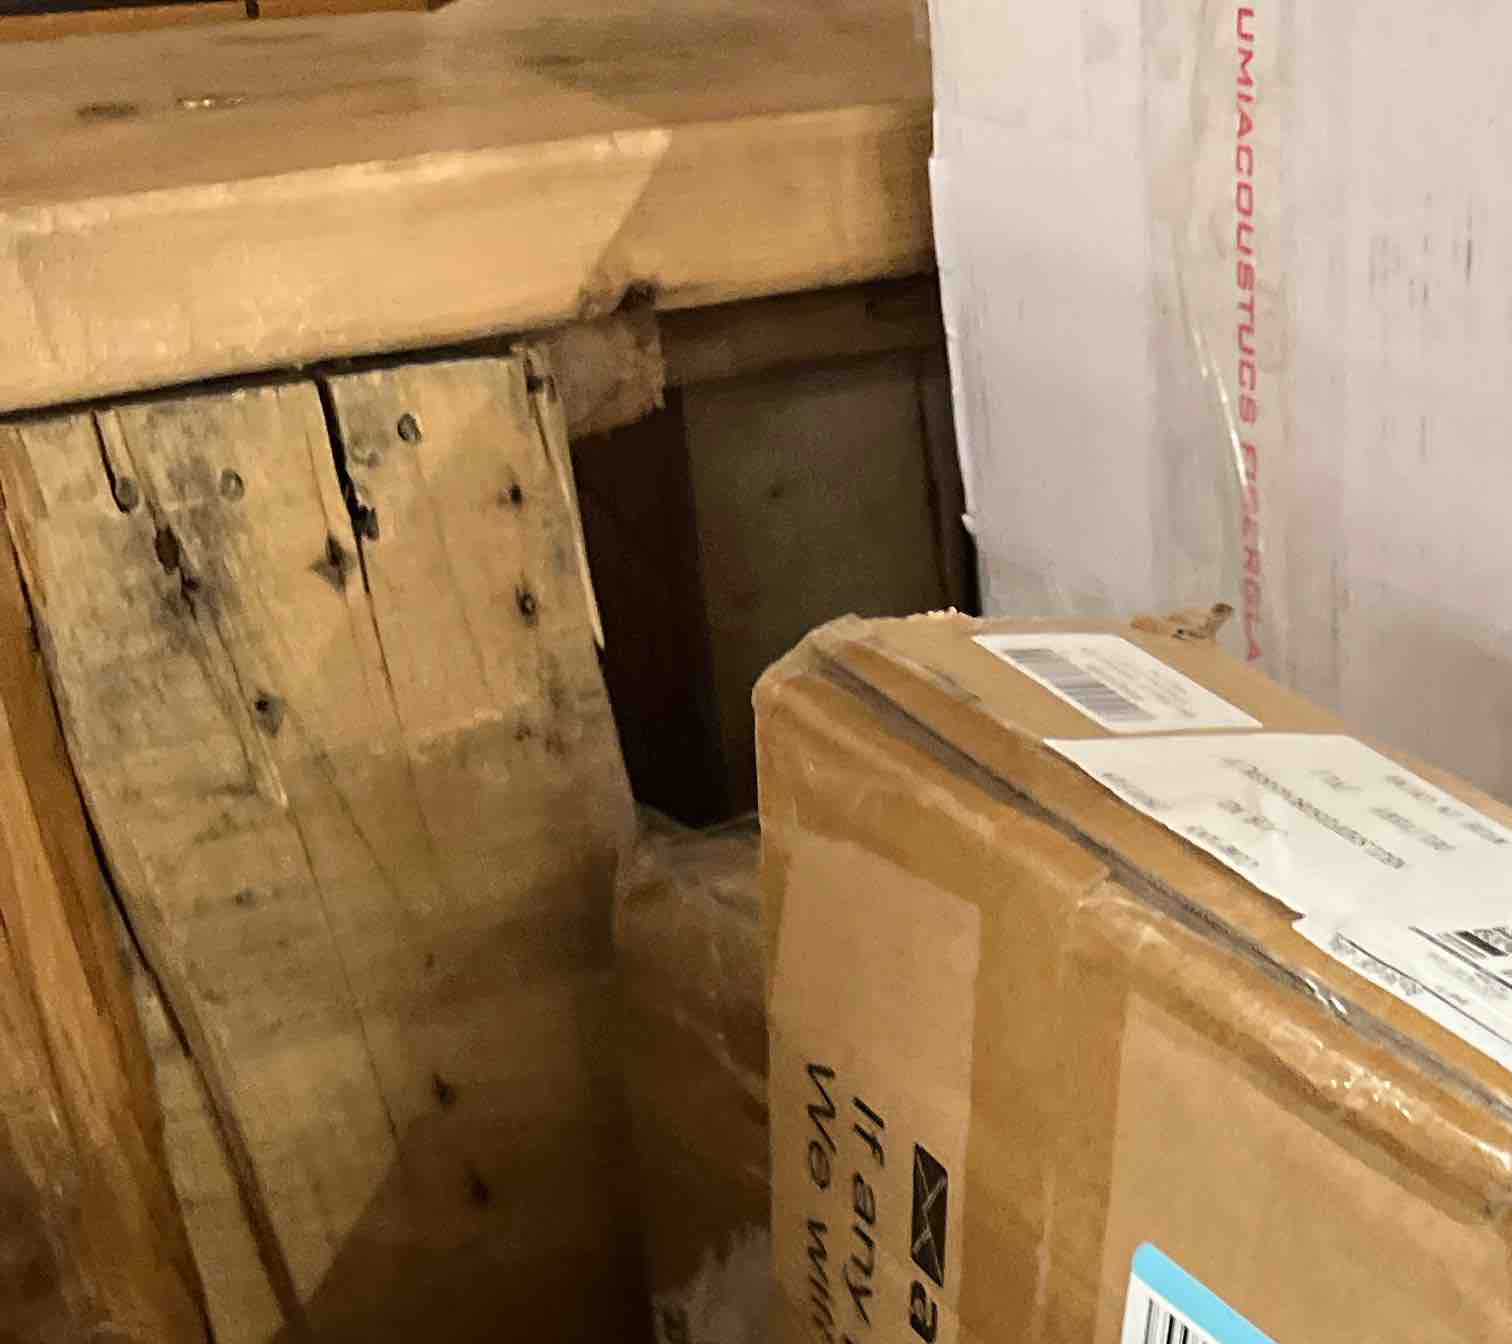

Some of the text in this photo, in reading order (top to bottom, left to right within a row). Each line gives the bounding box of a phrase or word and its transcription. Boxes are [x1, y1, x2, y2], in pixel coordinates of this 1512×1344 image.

[806, 1062, 838, 1191] We
[852, 1095, 886, 1169] If
[841, 1172, 878, 1327] any
